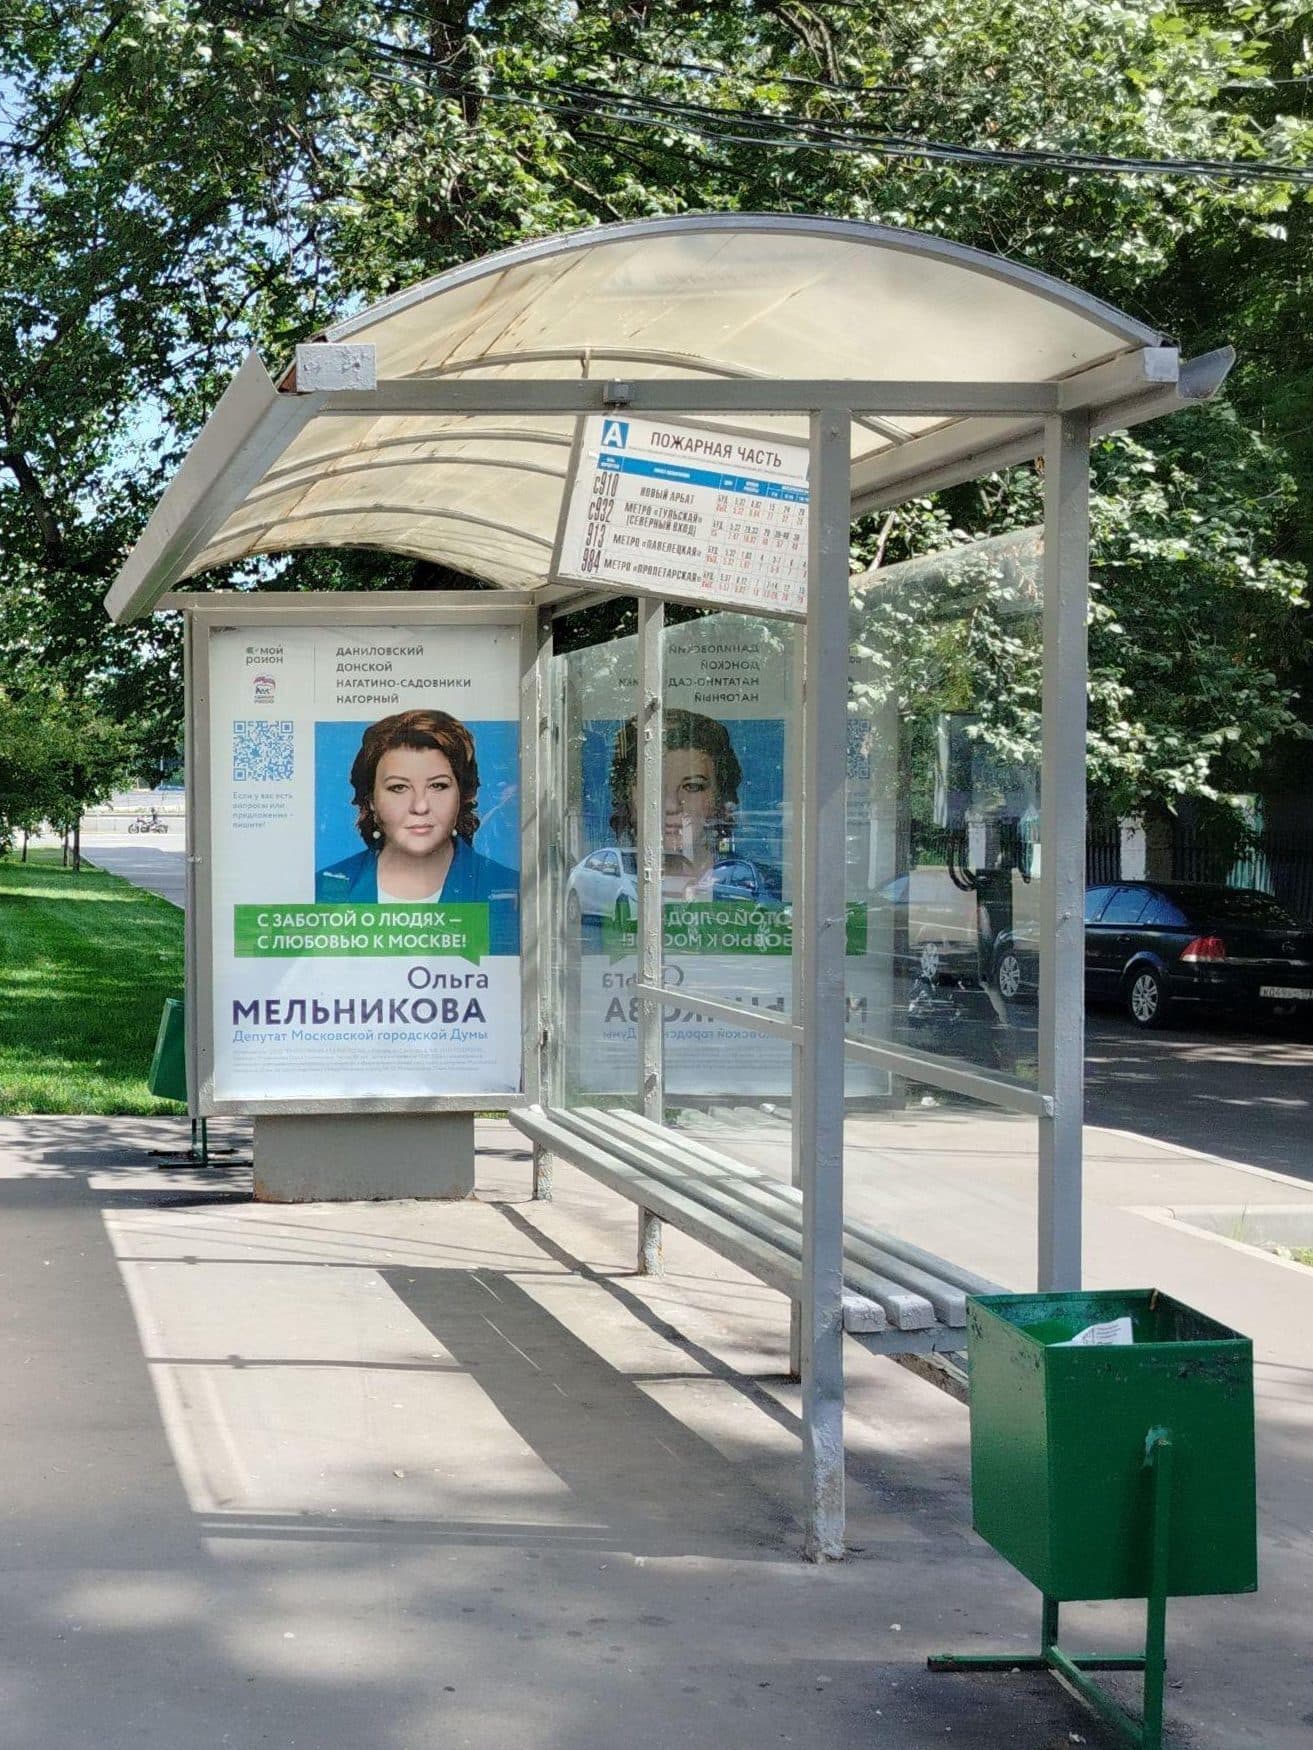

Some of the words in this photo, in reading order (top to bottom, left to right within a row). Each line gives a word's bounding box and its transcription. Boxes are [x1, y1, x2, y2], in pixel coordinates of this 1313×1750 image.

[650, 431, 733, 459] ПОЖАРНАЯ
[737, 446, 783, 468] ЧАСТЬ
[639, 486, 669, 501] НОВЫЙ
[670, 491, 696, 505] АРБАТ
[587, 496, 615, 523] с932
[624, 501, 653, 516] МЕТРО
[653, 506, 703, 524] «ТУЛЬСКАЯ»
[585, 522, 607, 548] 913
[612, 533, 640, 548] МЕТРО
[641, 538, 702, 557] «ПАВЕЛЕЦКАЯ»
[581, 547, 602, 574] 984
[603, 558, 631, 572] МЕТРО
[632, 563, 702, 583] «ПРОЛЕТАРСКАЯ»
[259, 644, 284, 655] мой
[335, 645, 424, 657] ДАНИЛОВСКИЙ
[335, 661, 393, 673] ДОНСКОЙ
[336, 678, 472, 690] НАГАТИНО-САДОВНИКИ
[336, 693, 399, 704] НАГОРНЫЙ
[257, 912, 269, 928] С
[272, 910, 357, 928] ЗАБОТОЙ
[360, 912, 375, 927] О
[377, 911, 446, 929] ЛЮДЯХ
[257, 934, 269, 950] С
[272, 934, 369, 950] ЛЮБОВЬЮ
[373, 934, 385, 949] К
[388, 934, 467, 949] МОСКВЕ!
[407, 965, 489, 990] Ольга
[232, 997, 487, 1026] МЕЛЬНИКОВА
[232, 1029, 287, 1044] Депутат
[291, 1028, 376, 1042] Московской
[377, 1028, 448, 1044] городской
[449, 1028, 489, 1043] Думы
